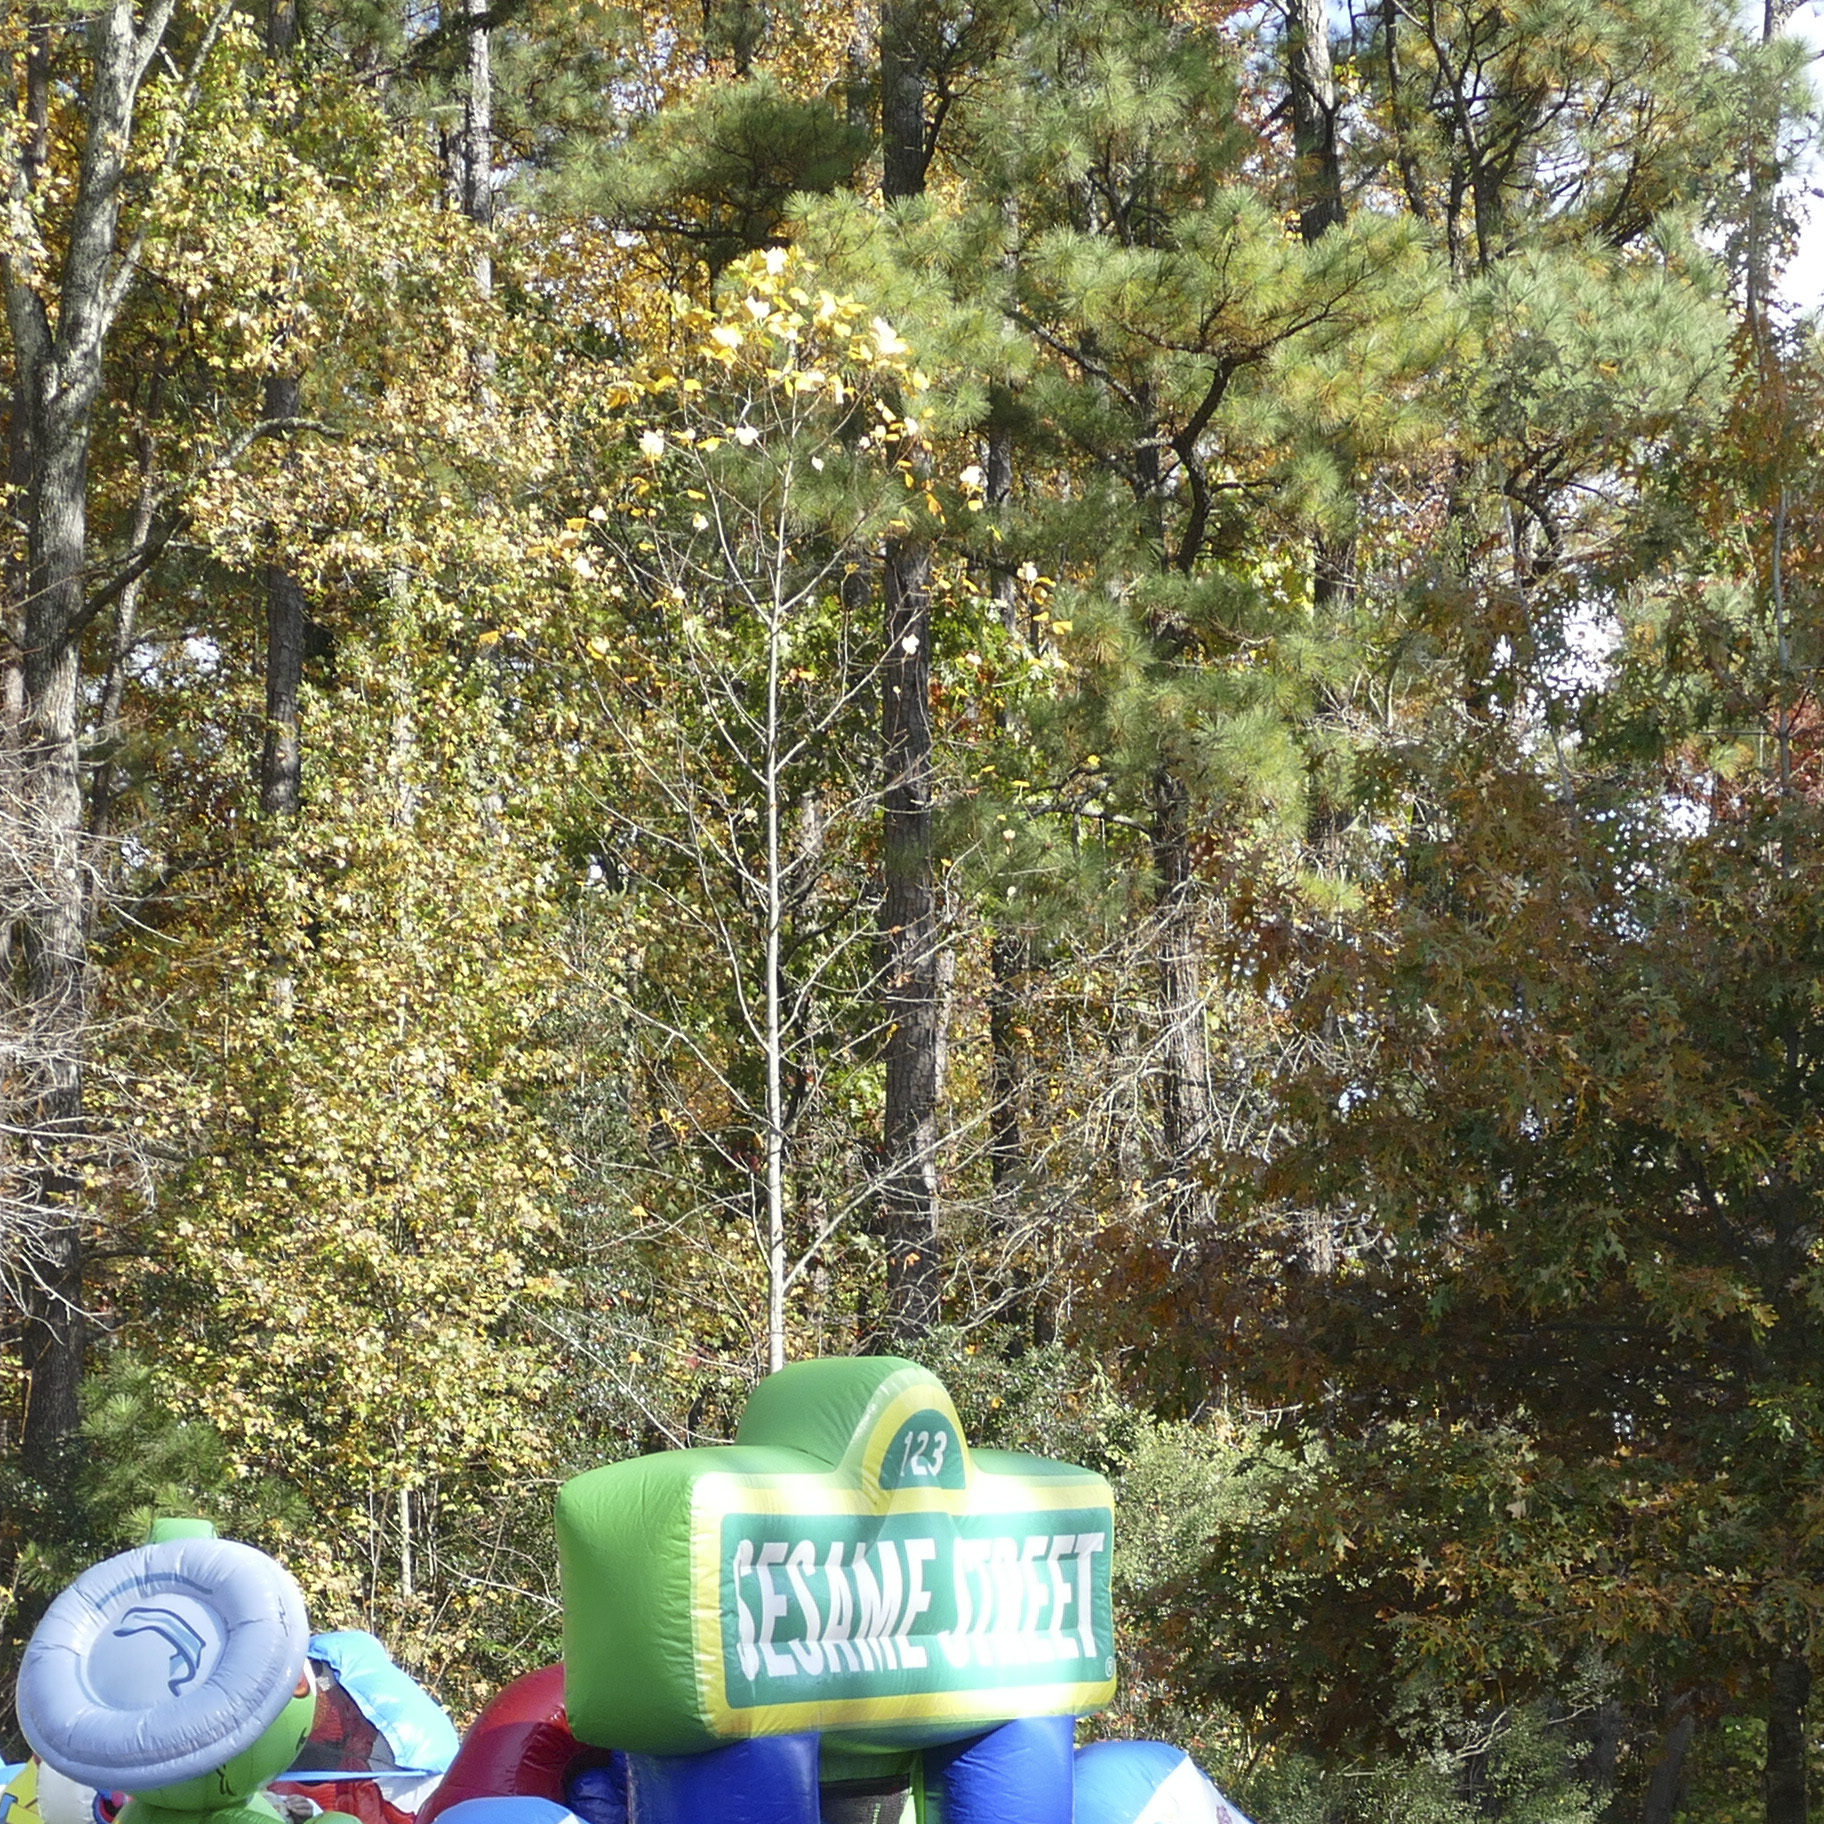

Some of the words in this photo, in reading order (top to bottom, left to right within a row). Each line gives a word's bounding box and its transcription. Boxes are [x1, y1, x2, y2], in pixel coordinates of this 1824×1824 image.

[900, 1429, 949, 1477] 123
[734, 1537, 937, 1681] SESAME
[937, 1531, 1106, 1668] STREET
